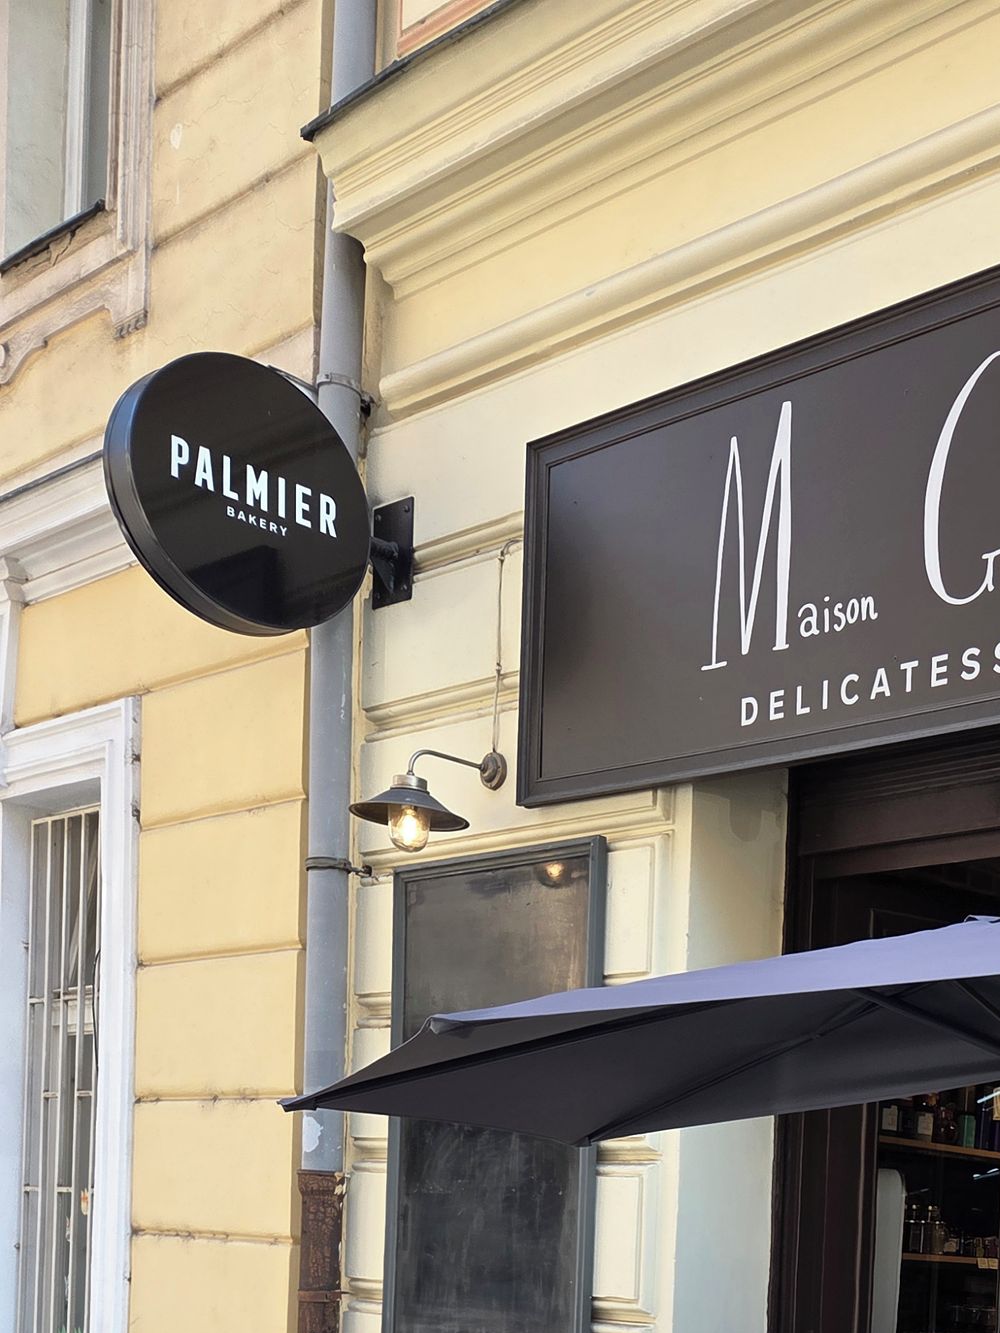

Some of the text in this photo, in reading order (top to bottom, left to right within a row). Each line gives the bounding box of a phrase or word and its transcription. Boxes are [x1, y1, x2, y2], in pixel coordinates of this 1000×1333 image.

[170, 433, 338, 539] PALMIER
[226, 505, 288, 537] BAKERY
[700, 400, 878, 670] Maison
